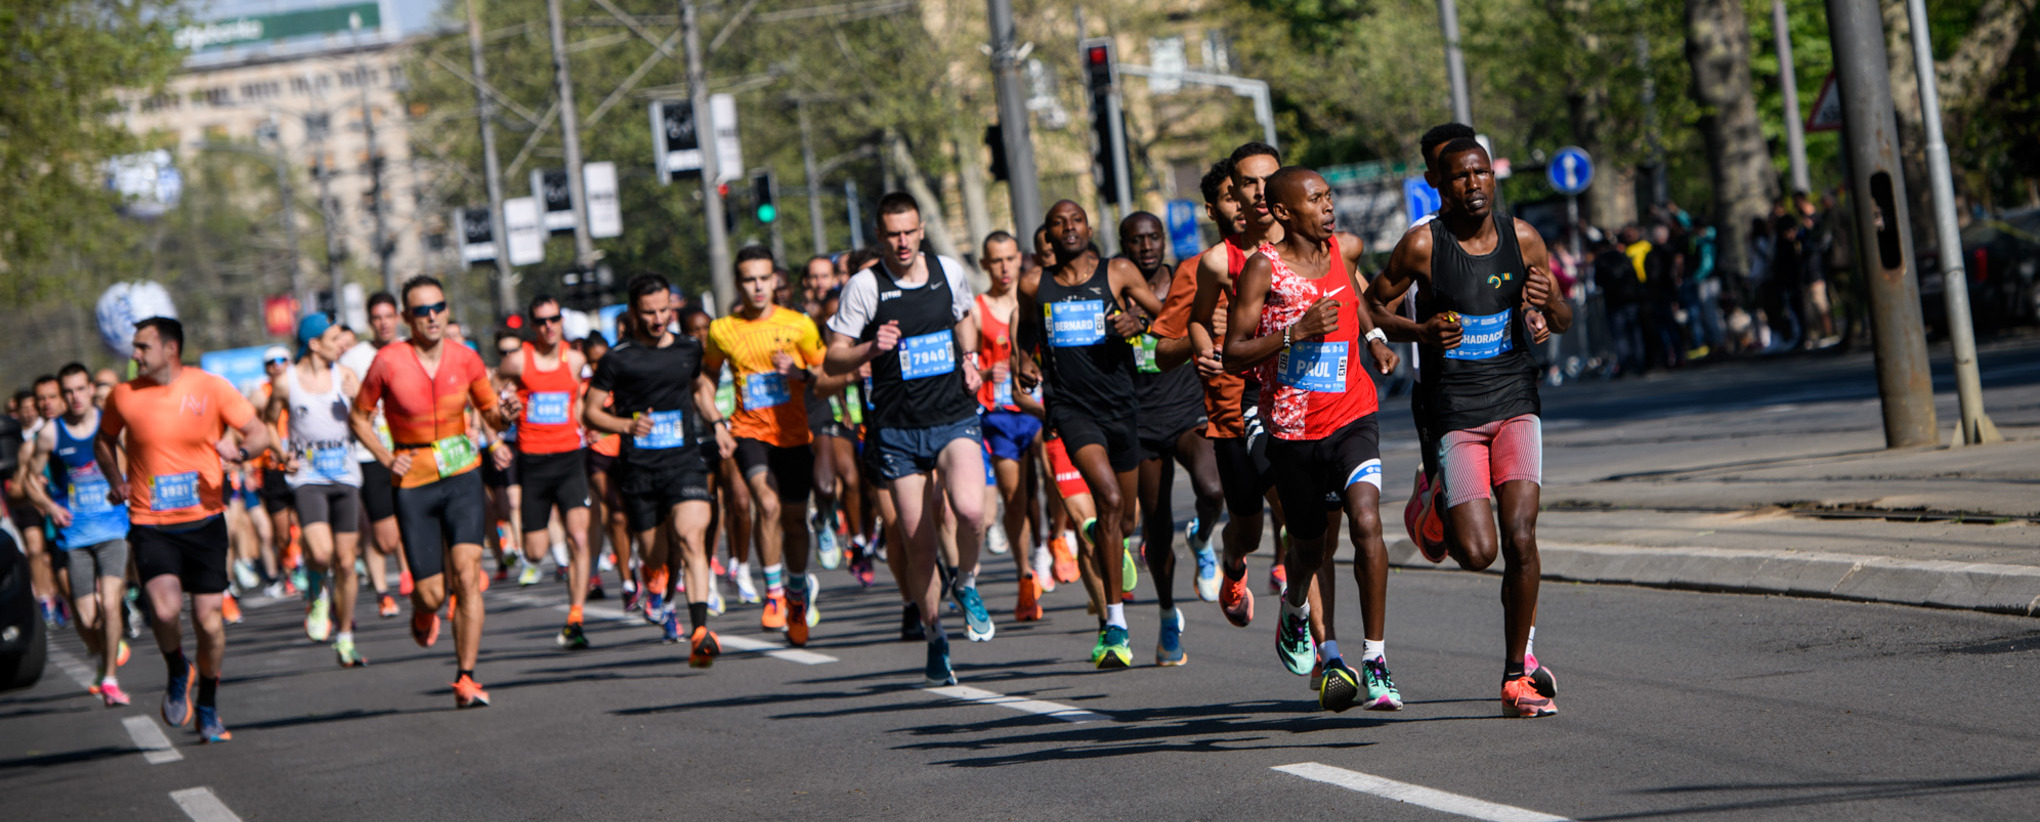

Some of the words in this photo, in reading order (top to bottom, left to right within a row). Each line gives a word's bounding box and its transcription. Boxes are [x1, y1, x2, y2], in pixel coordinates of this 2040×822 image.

[1054, 320, 1094, 332] BERNARD
[913, 348, 946, 365] 7940
[1296, 360, 1331, 378] PAUL
[160, 484, 189, 498] 3921
